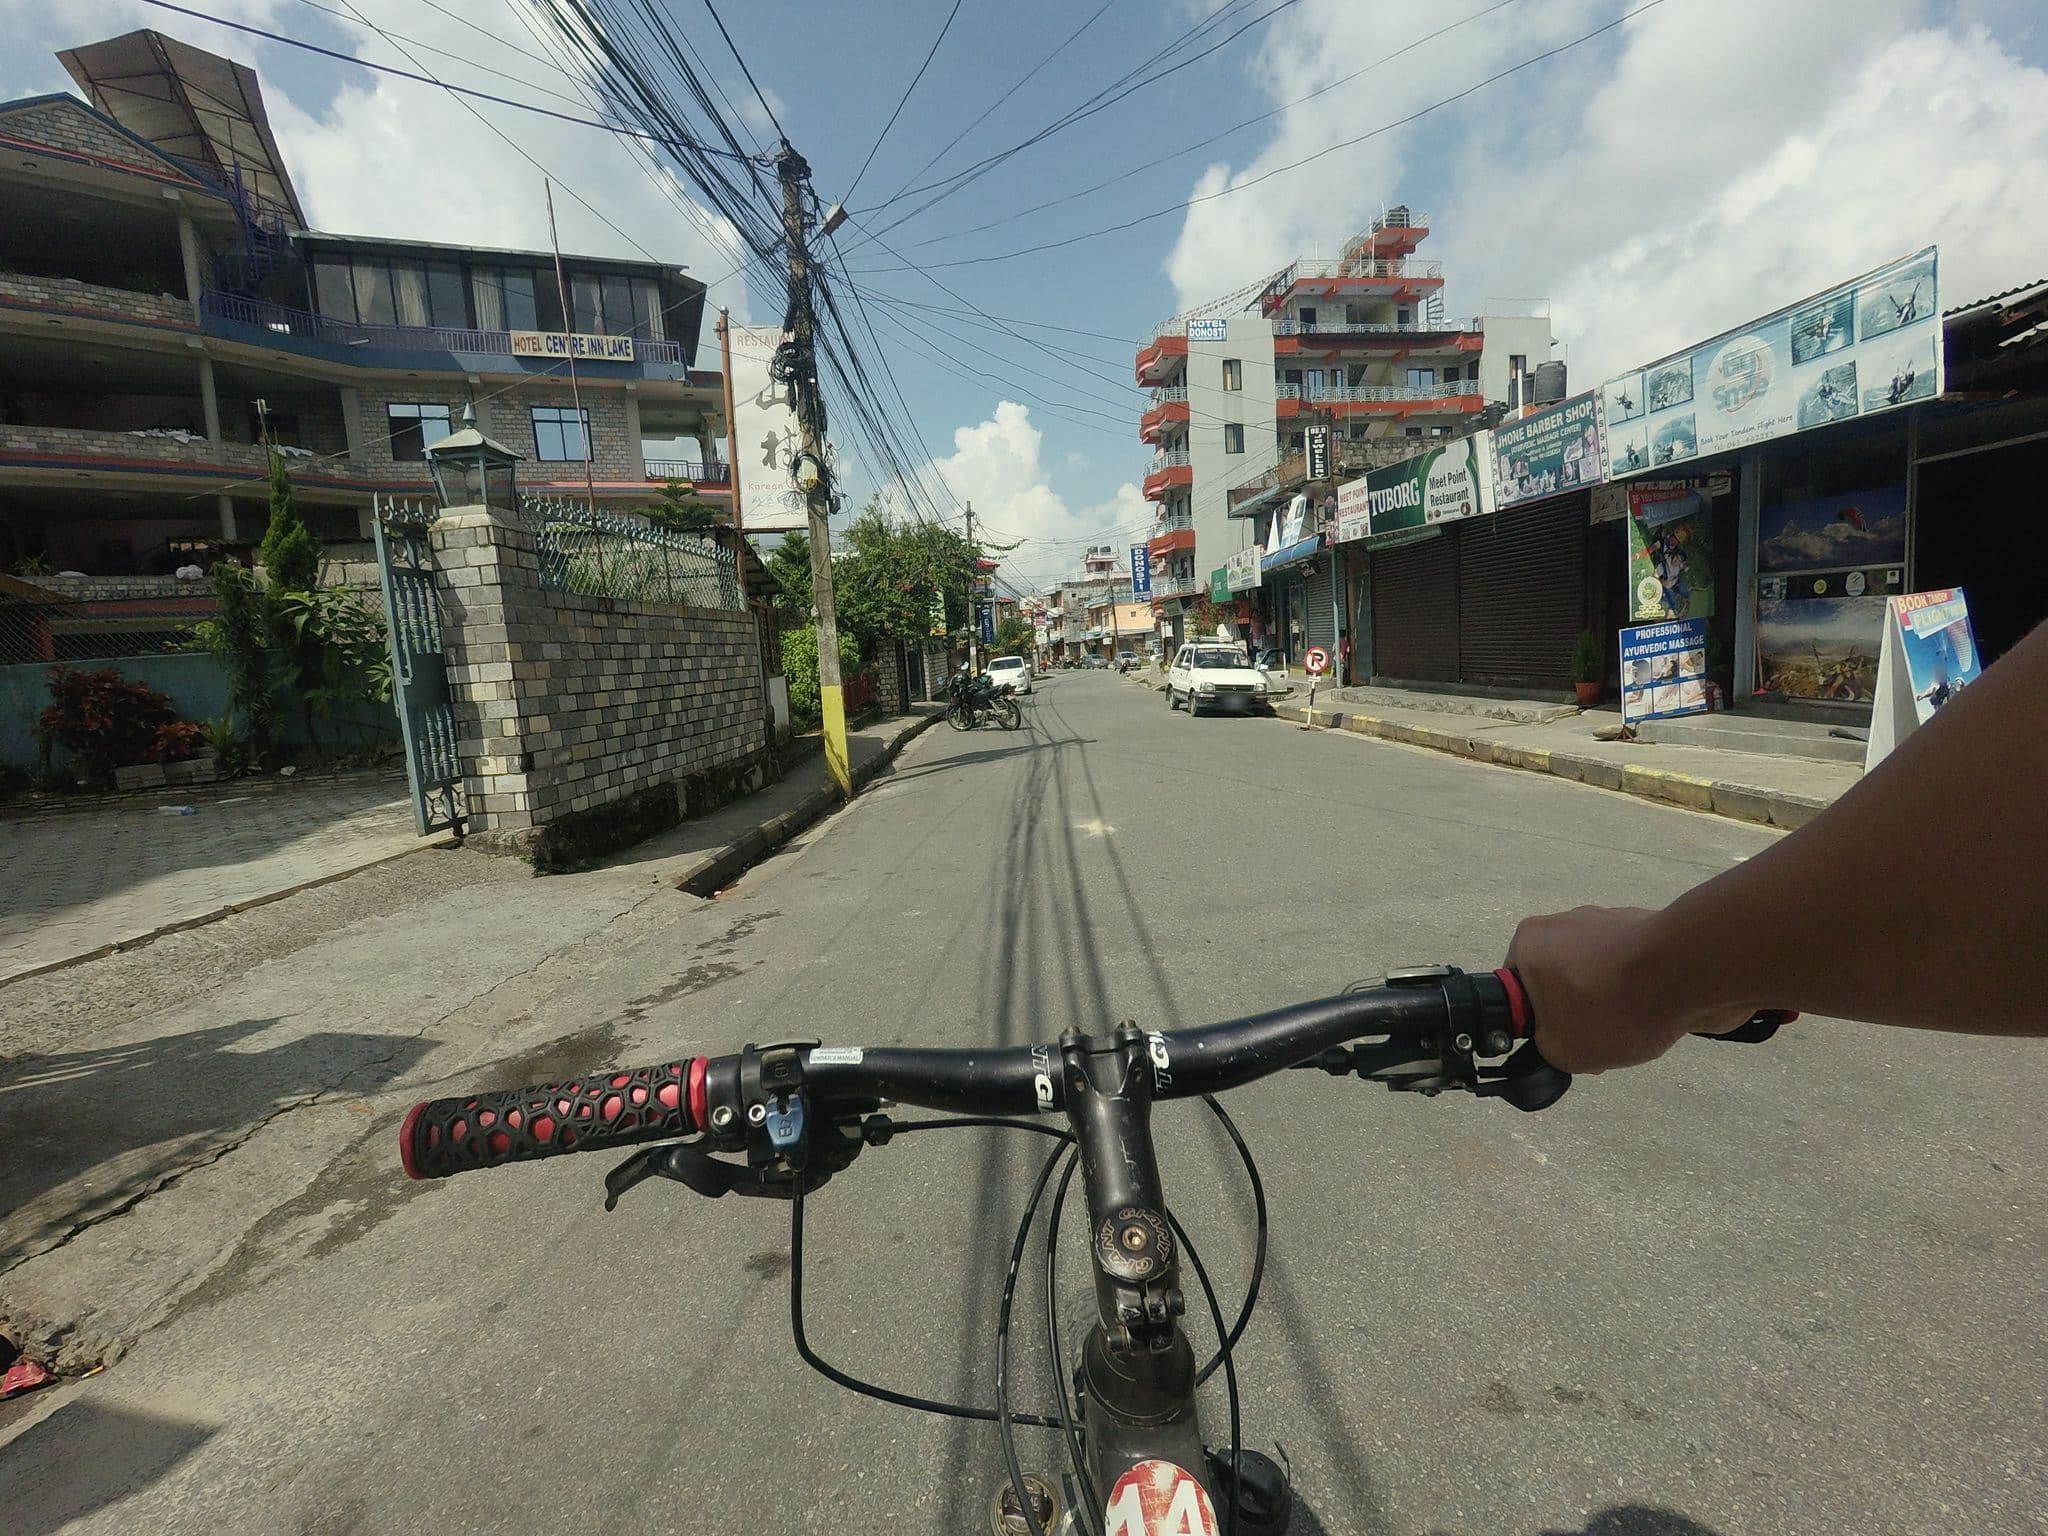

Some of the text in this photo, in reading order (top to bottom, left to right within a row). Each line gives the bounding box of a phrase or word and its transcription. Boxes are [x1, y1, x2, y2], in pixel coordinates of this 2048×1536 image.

[1190, 328, 1226, 336] DONOSTI
[514, 336, 542, 352] HOTEL
[588, 337, 604, 355] INN
[607, 339, 631, 357] LAKE
[1526, 412, 1564, 438] BARBER
[1565, 401, 1592, 423] SHOP
[1595, 392, 1608, 480] MASSAGE
[748, 481, 784, 491] Korean
[1429, 468, 1467, 490] Meet Point
[1339, 486, 1367, 503] MEET POINT
[1369, 477, 1421, 517] TUBORG
[1430, 487, 1470, 507] Restaurant
[1134, 548, 1145, 592] DONOSTI
[1897, 594, 1928, 613] BOOK
[1636, 622, 1693, 640] PROFESSIONAL
[1624, 635, 1704, 658] AYURVEDIC MASSAGE
[1119, 1207, 1171, 1262] GIANT
[1100, 1218, 1154, 1275] GIANT
